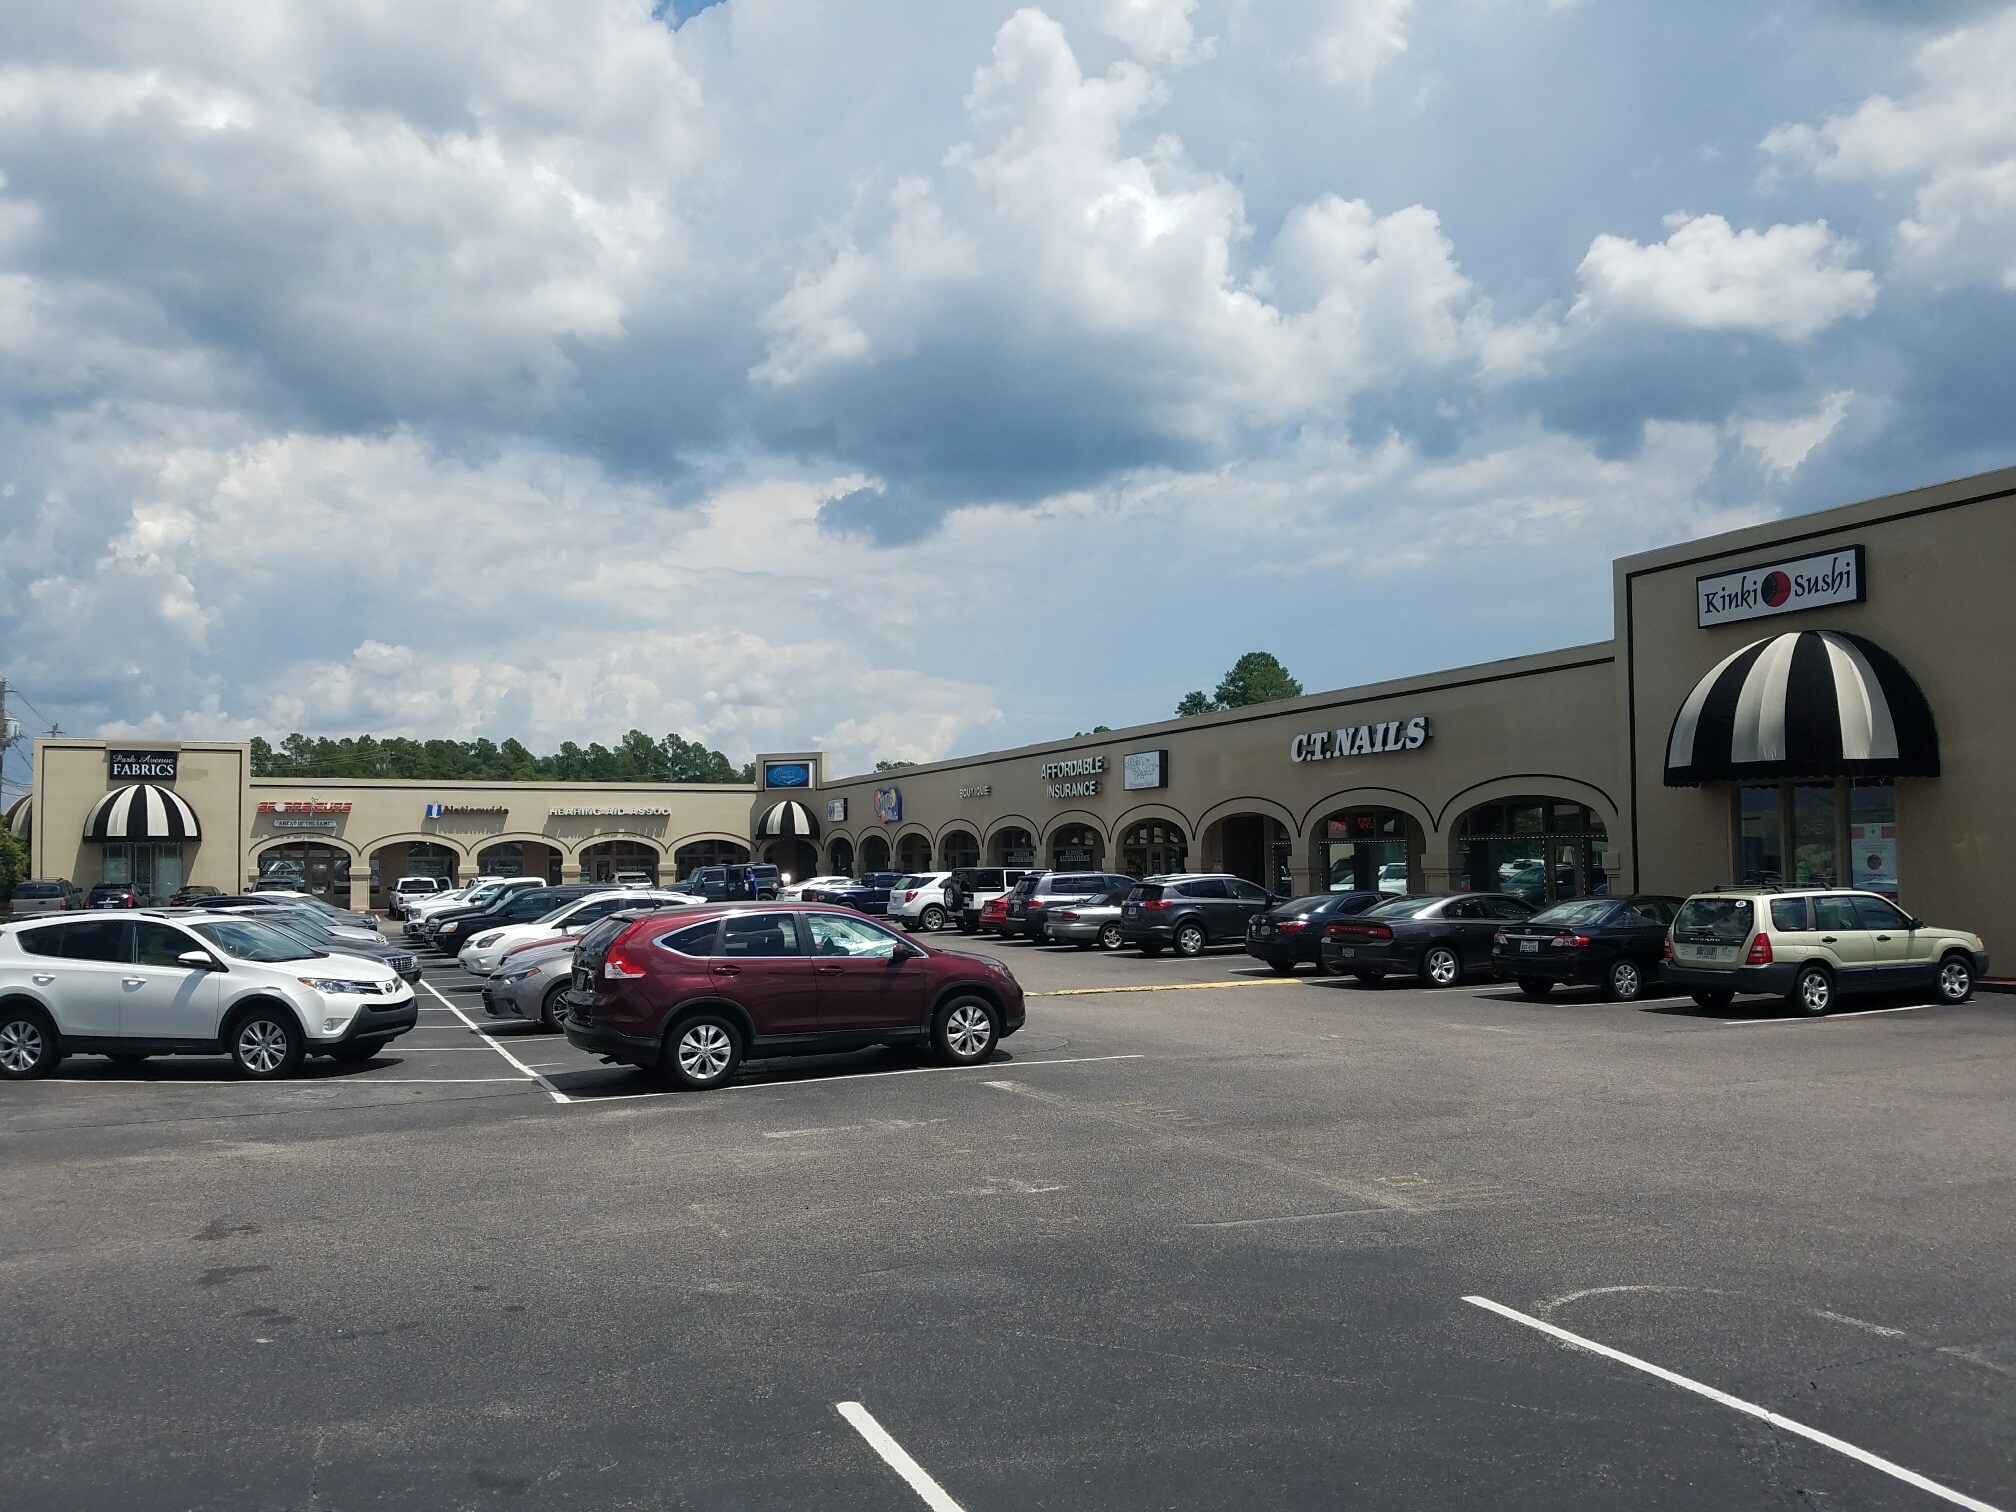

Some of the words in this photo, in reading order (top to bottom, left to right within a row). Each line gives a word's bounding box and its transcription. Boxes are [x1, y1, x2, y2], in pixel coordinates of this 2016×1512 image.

[1704, 575, 1758, 614] Kinki
[1794, 556, 1851, 597] Sushi
[112, 753, 136, 763] Park
[139, 754, 174, 764] Avenue
[113, 763, 174, 776] FABRICS
[1040, 755, 1104, 780] AFFORDABLE
[959, 784, 991, 799] BOUTIQUE
[1046, 780, 1097, 799] INSURANCE
[443, 805, 509, 816] Nationwide
[549, 807, 601, 816] HEARING
[605, 807, 625, 816] AID
[630, 807, 671, 816] ASSOC
